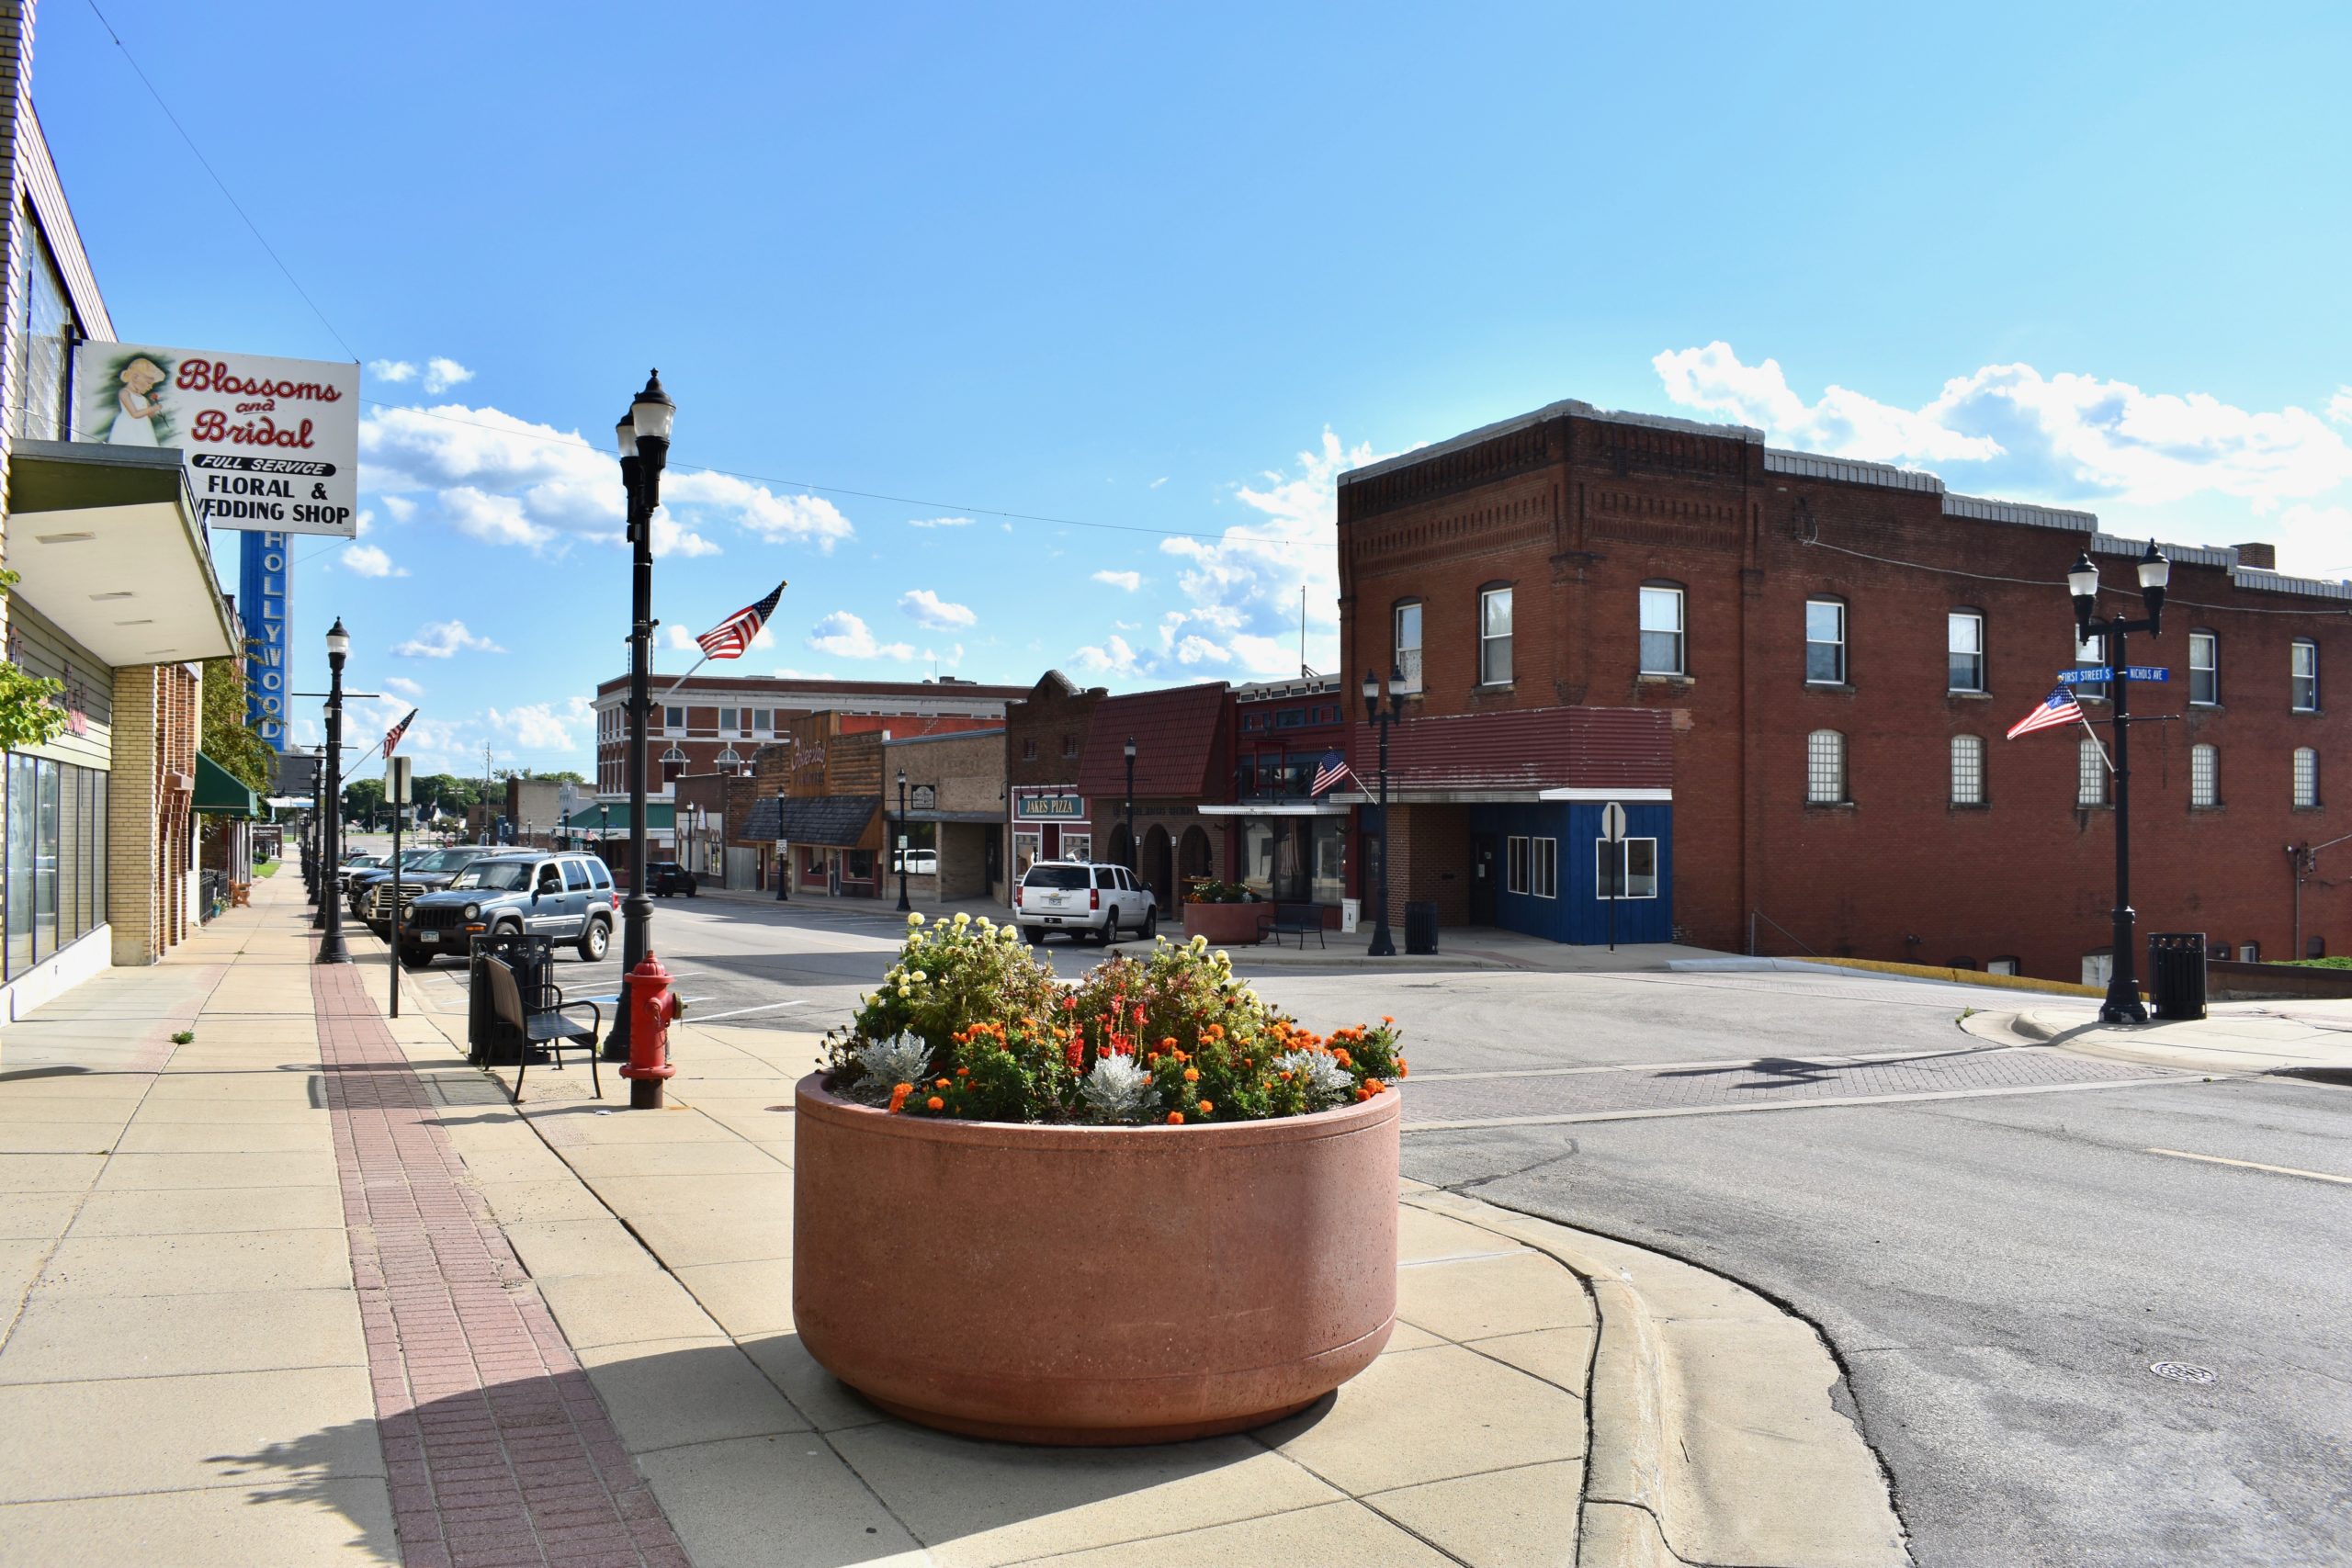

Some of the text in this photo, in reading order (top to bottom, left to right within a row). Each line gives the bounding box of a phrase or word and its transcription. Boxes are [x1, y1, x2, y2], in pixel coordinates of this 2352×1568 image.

[175, 358, 342, 402] Blossoms
[235, 399, 276, 413] and
[191, 409, 315, 449] Bridal
[200, 456, 327, 475] FULL SERVICE
[208, 475, 328, 500] FLORAL &
[292, 504, 350, 525] SHOP
[262, 531, 284, 739] HOLLYWOOD
[2061, 669, 2110, 682] FIRST STREET S
[2130, 668, 2163, 680] NICHOLS AVE
[1051, 799, 1073, 813] PIZZA
